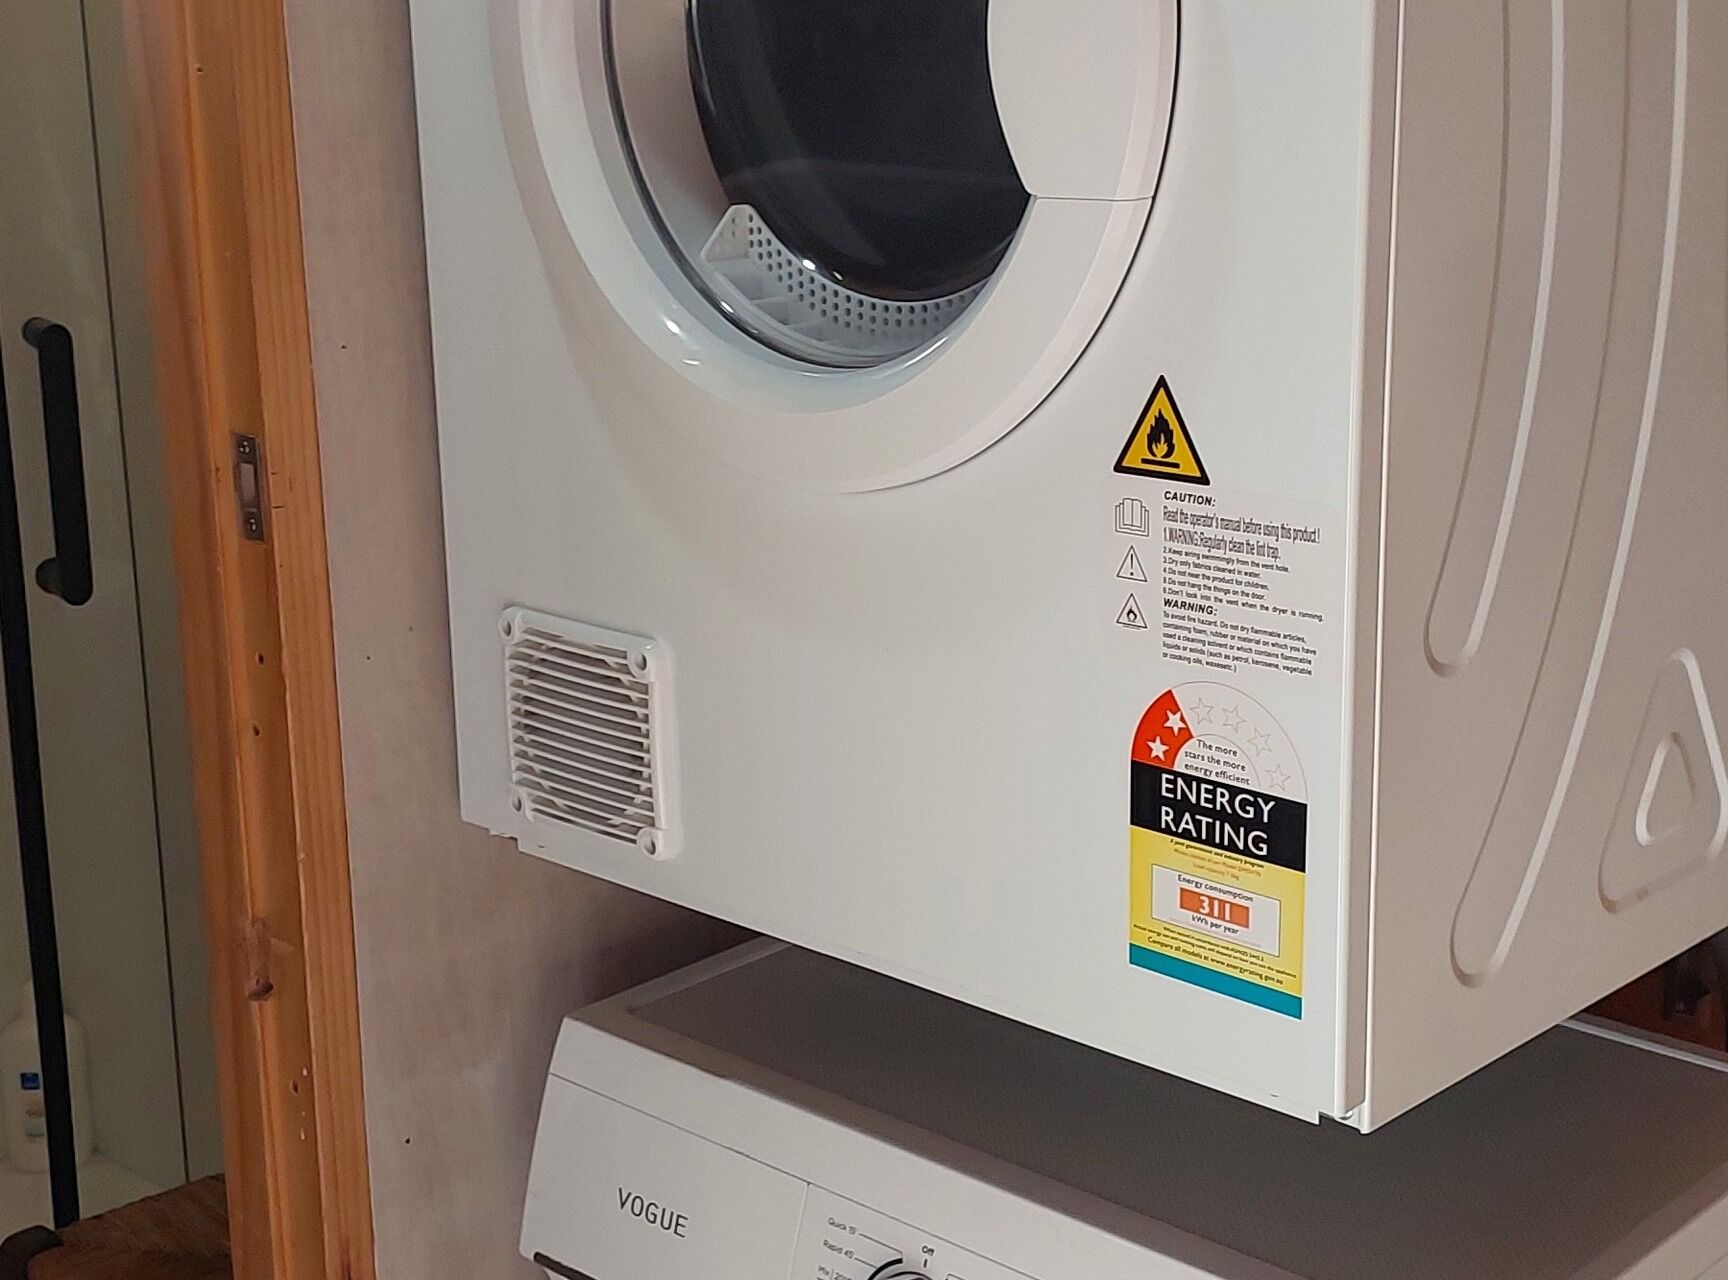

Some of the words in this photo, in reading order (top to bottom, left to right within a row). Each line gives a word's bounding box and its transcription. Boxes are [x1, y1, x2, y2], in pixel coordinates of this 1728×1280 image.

[1164, 490, 1217, 507] CAUTION:
[1163, 505, 1178, 524] Read
[1180, 508, 1189, 525] the
[1190, 511, 1219, 530] operator's
[1220, 516, 1241, 533] manual
[1242, 517, 1262, 535] before
[1263, 520, 1280, 543] using
[1281, 523, 1292, 540] this
[1228, 535, 1245, 554] clean
[1246, 538, 1256, 556] the
[1256, 540, 1266, 558] lint
[1179, 560, 1191, 569] only
[1192, 561, 1212, 571] fabrics
[1213, 565, 1236, 575] cleaned
[1250, 560, 1260, 569] the
[1177, 570, 1187, 578] not
[1201, 573, 1211, 581] the
[1212, 576, 1234, 585] product
[1235, 578, 1243, 586] for
[1187, 581, 1202, 591] hang
[1202, 584, 1212, 592] the
[1213, 585, 1231, 596] things
[1240, 590, 1250, 598] the
[1164, 597, 1218, 617] WARNING:
[1213, 596, 1223, 604] the
[1241, 601, 1257, 609] when
[1260, 603, 1270, 612] the
[1272, 605, 1288, 616] dryer
[1291, 609, 1297, 617] is
[1163, 610, 1169, 618] To
[1171, 613, 1186, 621] avoid
[1187, 615, 1197, 624] fire
[1219, 621, 1229, 630] Do
[1240, 625, 1249, 635] dry
[1250, 626, 1281, 639] flammable
[1162, 632, 1176, 640] used
[1182, 635, 1206, 647] cleaning
[1207, 640, 1229, 650] solvent
[1236, 646, 1253, 655] which
[1210, 630, 1229, 639] rubber
[1237, 635, 1261, 646] material
[1271, 641, 1289, 651] which
[1289, 645, 1300, 654] you
[1301, 646, 1317, 656] have
[1169, 653, 1192, 664] cooking
[1206, 649, 1223, 659] (such
[1282, 665, 1312, 676] vegetable
[1196, 738, 1213, 752] The
[1215, 745, 1238, 757] more
[1184, 750, 1205, 762] stars
[1207, 754, 1221, 767] the
[1223, 761, 1246, 773] more
[1184, 763, 1212, 778] energy
[1215, 770, 1251, 786] efficient
[1161, 773, 1276, 824] ENERGY
[1161, 806, 1268, 857] RATING
[1178, 873, 1203, 890] Energy
[1205, 884, 1254, 903] consumption
[1199, 894, 1232, 922] 311
[1191, 914, 1209, 926] kWh
[1210, 920, 1223, 930] per
[1223, 924, 1239, 934] year
[1147, 936, 1173, 950] Compare
[1174, 945, 1182, 953] all
[1182, 948, 1203, 960] models
[618, 1186, 689, 1239] VOGUE
[921, 1244, 935, 1257] Off
